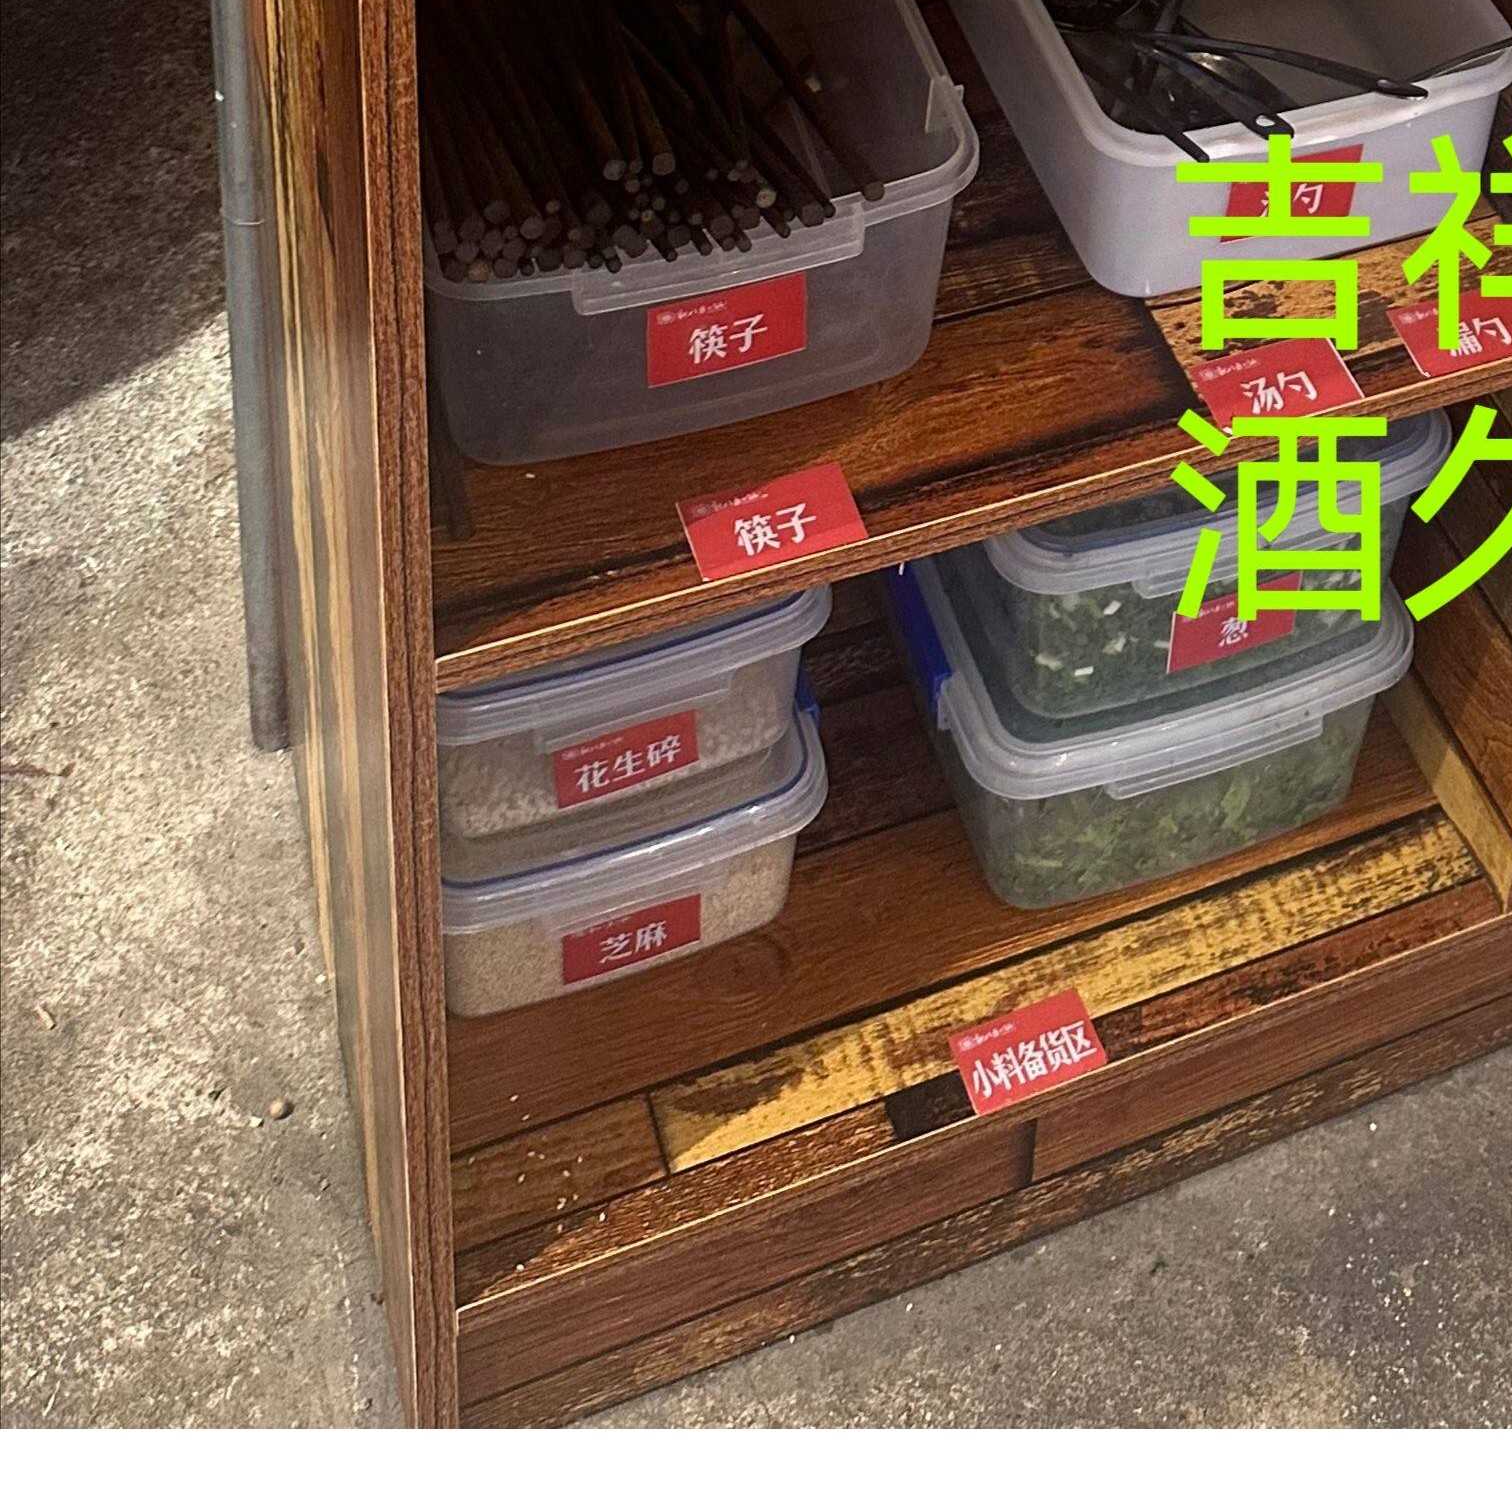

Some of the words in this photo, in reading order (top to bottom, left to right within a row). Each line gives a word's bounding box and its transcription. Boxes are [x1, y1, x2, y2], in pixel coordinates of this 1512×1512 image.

[688, 313, 769, 365] 筷子
[1240, 370, 1318, 415] 汤勺
[733, 502, 817, 557] 筷子
[574, 733, 682, 793] 花生碎
[599, 920, 668, 964] 芝麻
[972, 1019, 1098, 1098] 小料备货区
